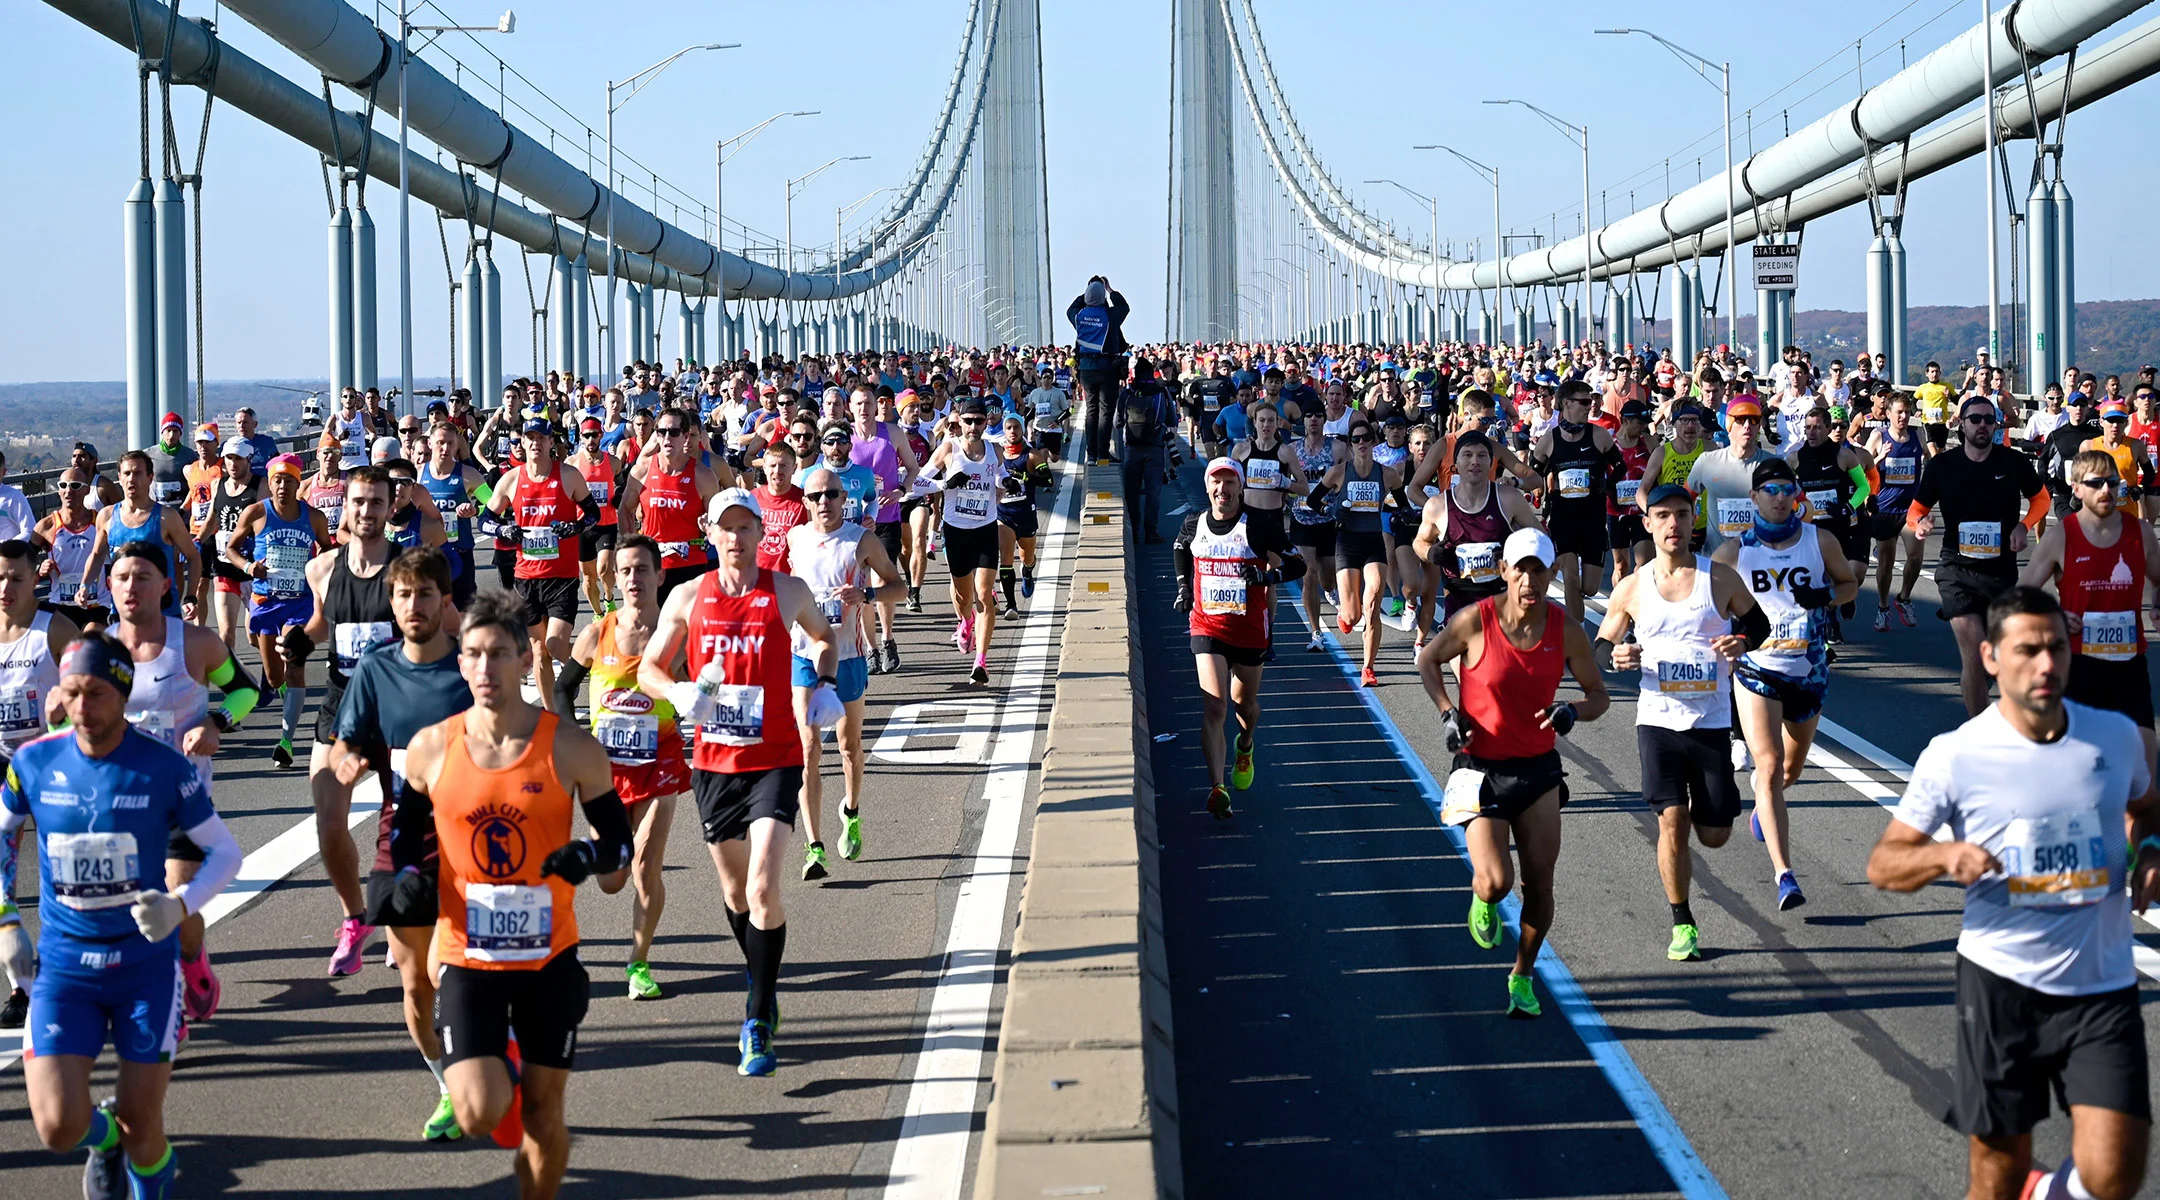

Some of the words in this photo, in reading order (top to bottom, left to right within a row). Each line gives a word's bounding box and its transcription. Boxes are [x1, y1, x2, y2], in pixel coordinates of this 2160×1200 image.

[1754, 246, 1776, 255] STATE
[1780, 246, 1796, 254] LAW
[1758, 261, 1794, 270] SPEEDING
[1759, 276, 1771, 284] FINE
[1892, 466, 1909, 475] 5273
[1351, 482, 1377, 490] ALEESA
[314, 495, 344, 508] LATVIA
[1355, 490, 1374, 501] 2853
[432, 500, 457, 509] YPD
[649, 496, 688, 510] FDNY
[966, 498, 981, 509] 1617
[1814, 500, 1830, 510] 229
[521, 504, 557, 517] FDNY
[1727, 510, 1751, 523] 2269
[283, 538, 297, 546] 43
[1970, 533, 1990, 546] 2150
[277, 578, 294, 590] 1392
[1751, 566, 1812, 593] BYG
[1210, 588, 1236, 602] 12097
[2097, 627, 2124, 644] 2128
[700, 634, 766, 654] FDNY
[1670, 663, 1704, 681] 2405
[716, 704, 744, 724] 1654
[112, 795, 150, 810] ITALIA
[466, 804, 497, 826] BULL
[500, 803, 528, 823] CITY
[2033, 842, 2078, 875] 5138
[74, 858, 114, 882] 1243
[490, 910, 530, 936] 1362
[80, 950, 122, 965] ITALIA
